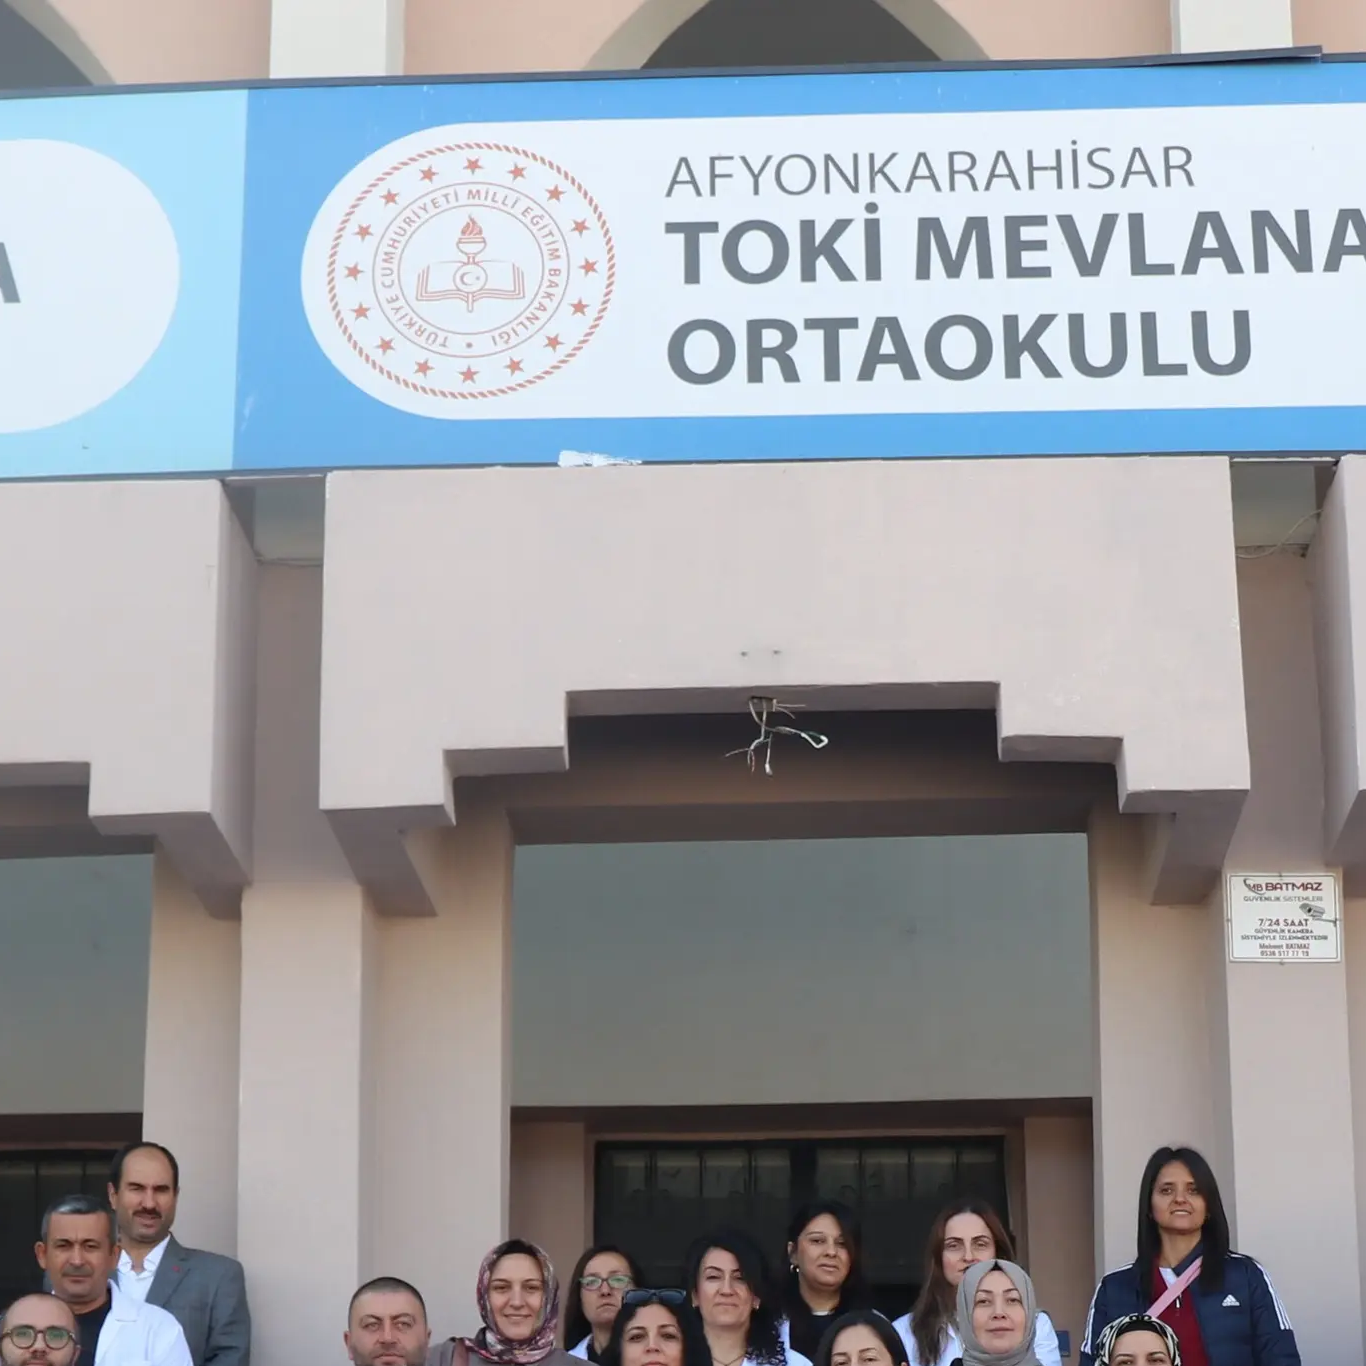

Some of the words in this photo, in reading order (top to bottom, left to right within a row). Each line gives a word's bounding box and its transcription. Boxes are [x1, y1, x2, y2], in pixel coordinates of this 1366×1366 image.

[665, 140, 1195, 197] AFYONKARAHİSAR
[467, 188, 520, 209] MİLLİ
[381, 188, 459, 288] CUMHURİYETİ
[521, 206, 561, 261] EĞİTİM
[665, 202, 882, 285] TOKİ
[386, 294, 449, 348] TÜRKİYE
[491, 268, 561, 346] BAKANLIĞI
[667, 310, 1252, 386] ORTAOKULU
[1265, 882, 1323, 891] BATMAZ
[1258, 918, 1280, 927] 7/24
[1283, 918, 1309, 927] SAAT
